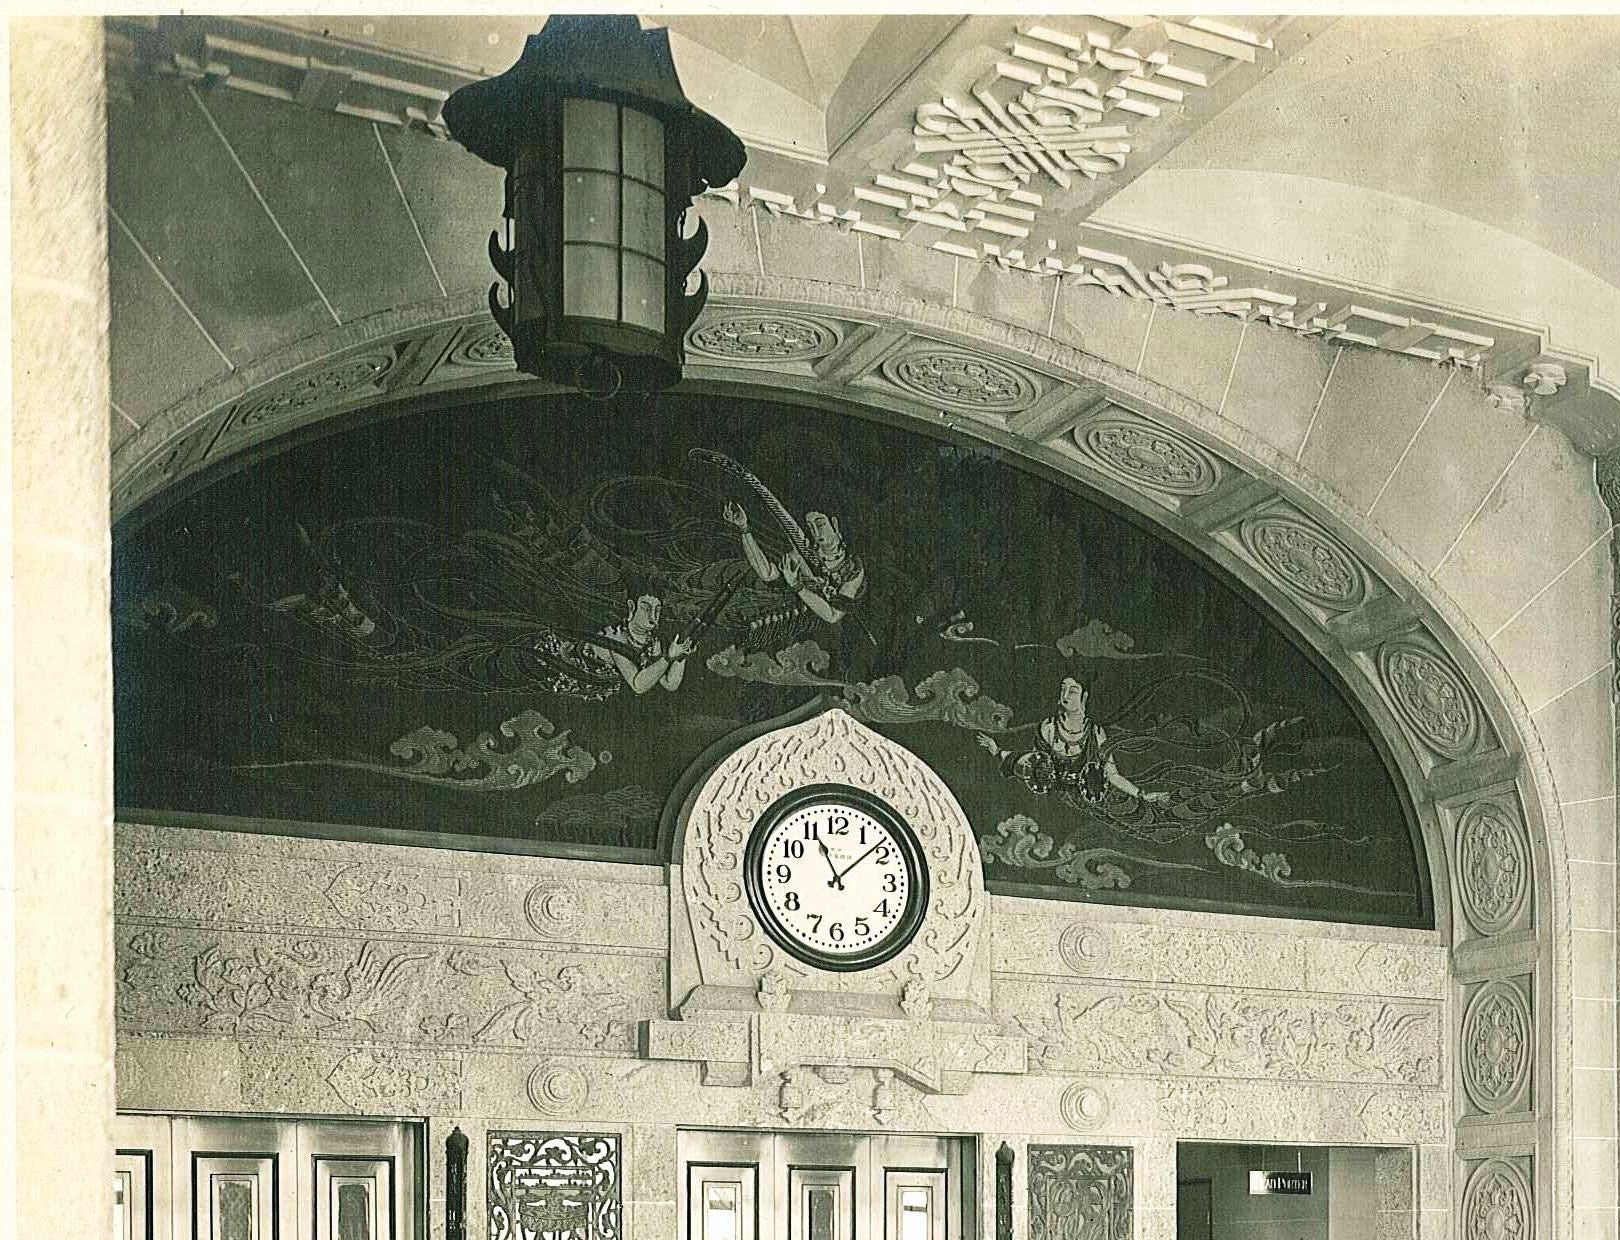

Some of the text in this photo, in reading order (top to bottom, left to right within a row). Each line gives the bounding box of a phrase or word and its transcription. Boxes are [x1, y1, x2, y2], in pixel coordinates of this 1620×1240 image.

[803, 820, 819, 841] 11
[827, 815, 850, 836] 12
[859, 825, 867, 845] 1
[783, 838, 805, 859] 10
[875, 846, 890, 865] 2
[776, 864, 792, 884] 9
[882, 873, 897, 893] 3
[783, 891, 801, 912] 8
[872, 898, 891, 918] 4
[806, 913, 823, 934] 7
[829, 922, 845, 942] 6
[854, 916, 871, 936] 5
